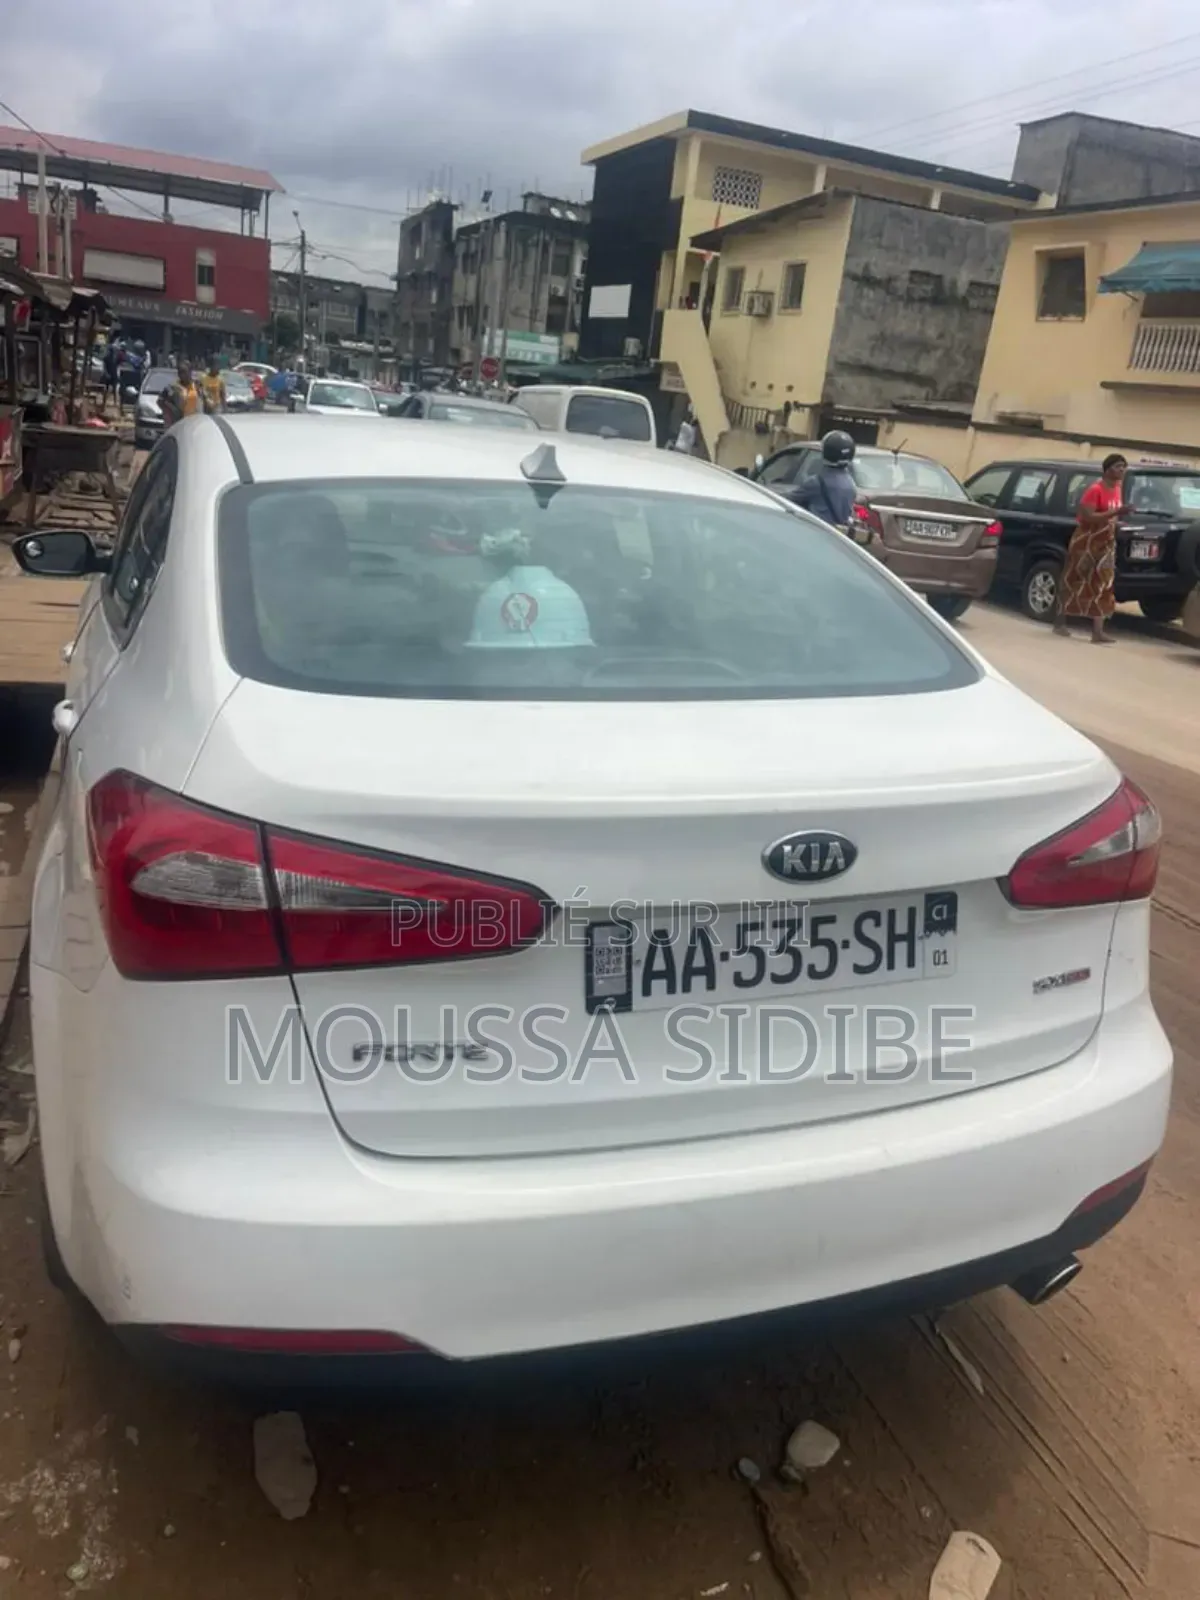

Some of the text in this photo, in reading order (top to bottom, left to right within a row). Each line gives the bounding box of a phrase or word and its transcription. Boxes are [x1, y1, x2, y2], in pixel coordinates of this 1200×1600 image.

[175, 305, 224, 321] FASHION
[782, 841, 846, 874] KIA
[931, 903, 948, 921] CI
[932, 948, 949, 967] 01
[352, 1042, 490, 1062] FORTE
